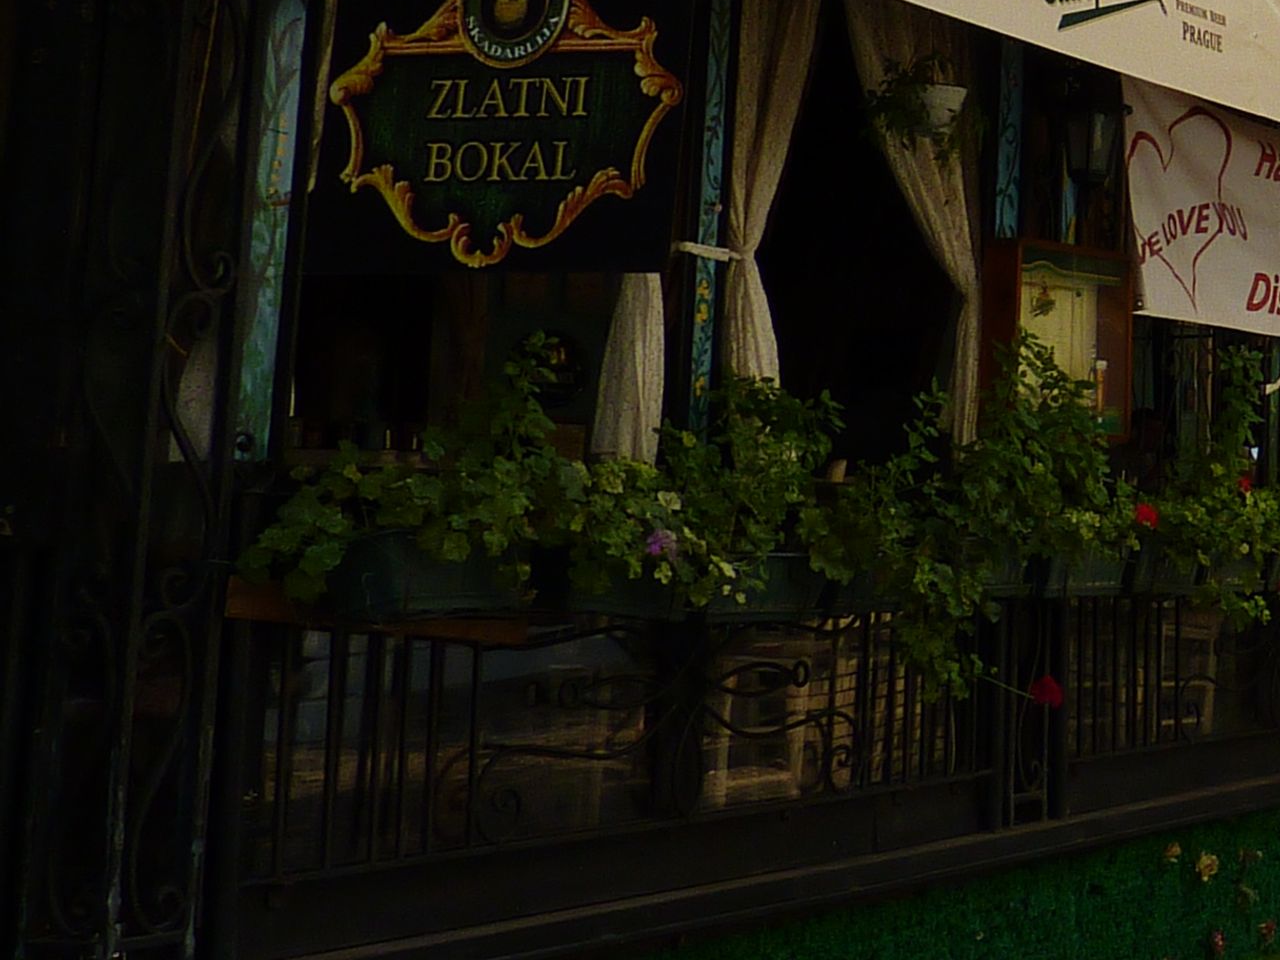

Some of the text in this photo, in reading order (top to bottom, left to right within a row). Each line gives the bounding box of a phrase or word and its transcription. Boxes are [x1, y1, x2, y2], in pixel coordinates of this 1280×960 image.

[467, 16, 560, 59] SKADARLIJA
[1182, 20, 1223, 53] PRAGUE
[426, 77, 589, 119] ZLATNI
[424, 141, 576, 181] BOKAL
[1162, 203, 1211, 246] LOVE
[1212, 202, 1248, 241] YOU
